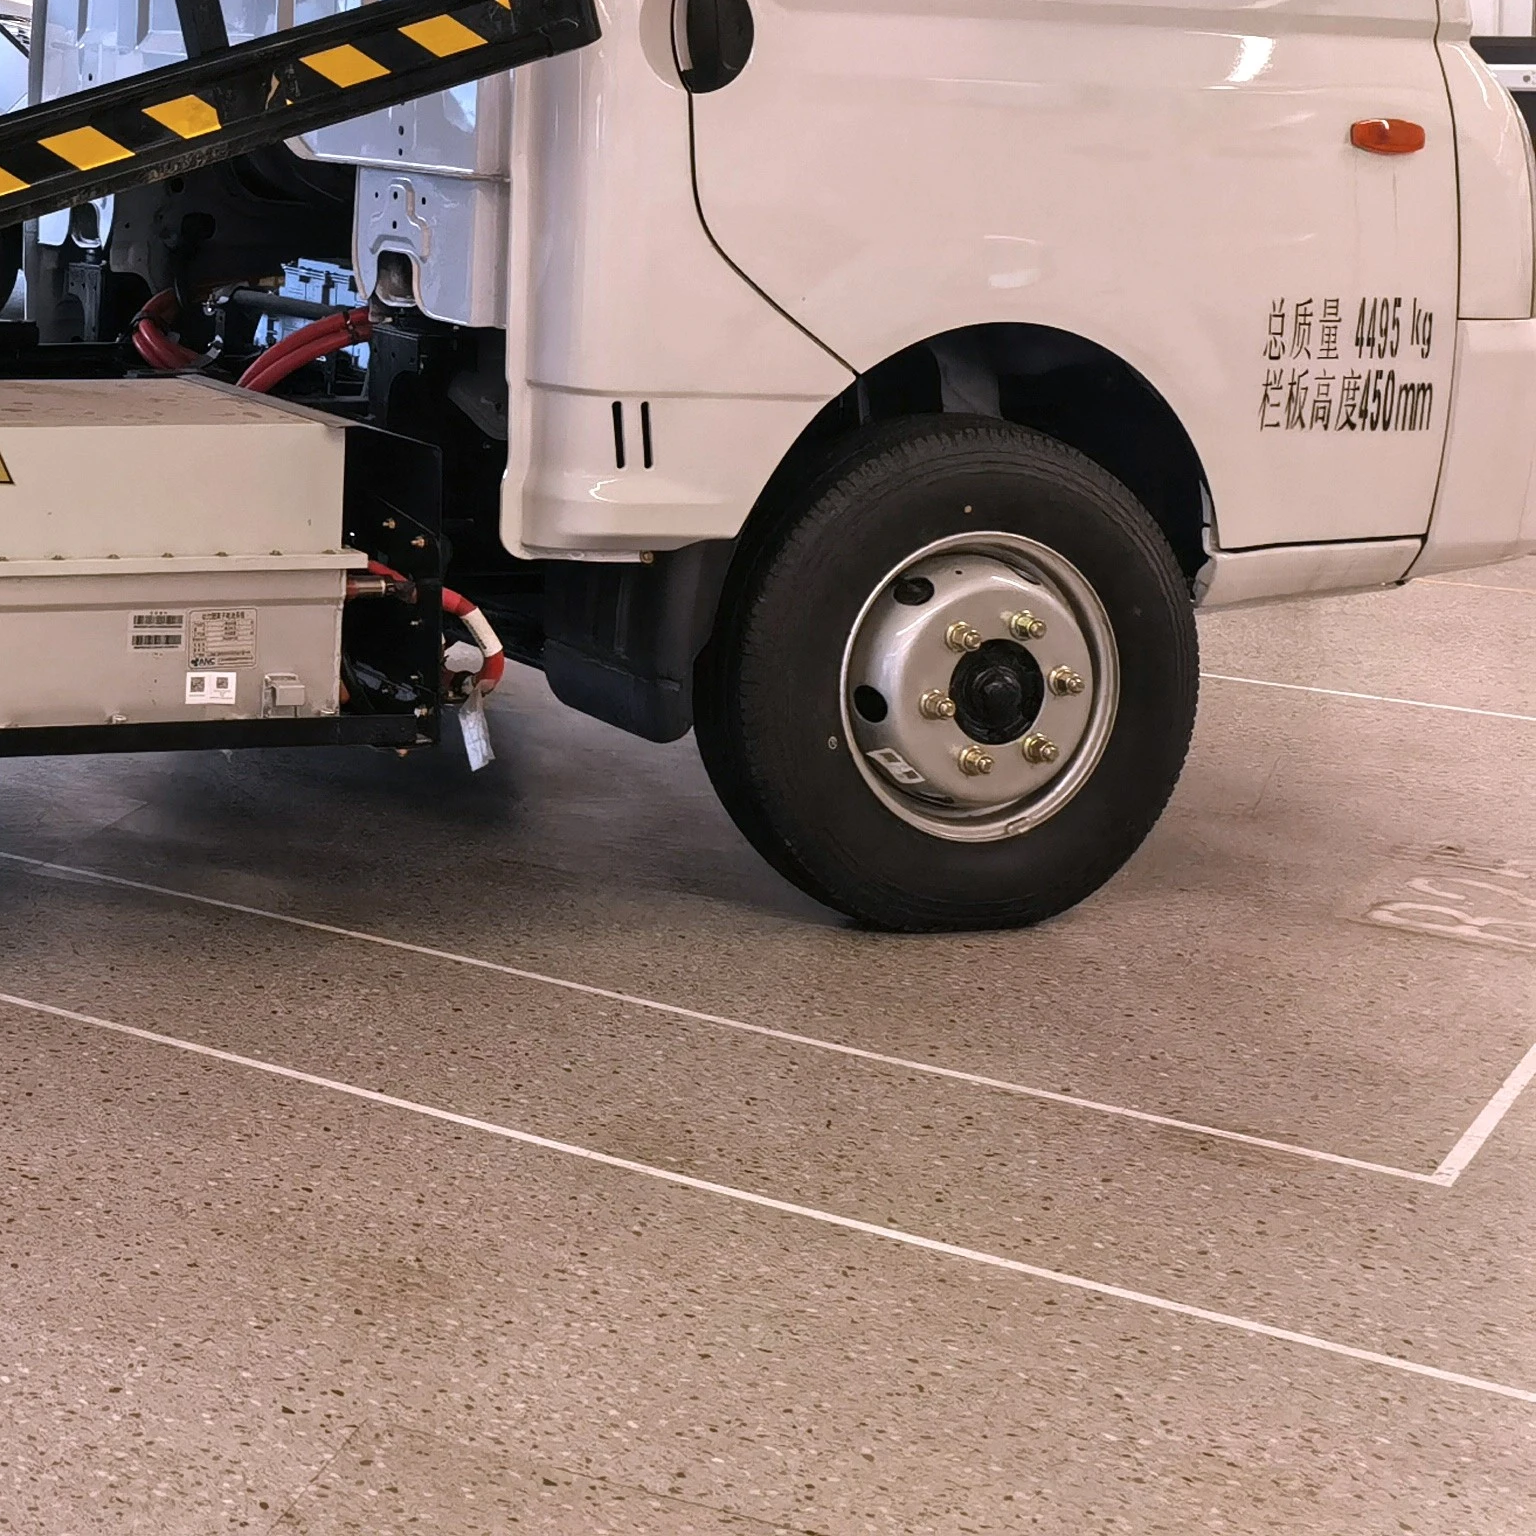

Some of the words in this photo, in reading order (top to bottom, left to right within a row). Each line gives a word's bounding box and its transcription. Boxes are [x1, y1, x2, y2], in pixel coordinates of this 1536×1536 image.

[1263, 297, 1342, 360] 总质量
[1355, 297, 1402, 358] 4495
[1411, 297, 1433, 358] kg
